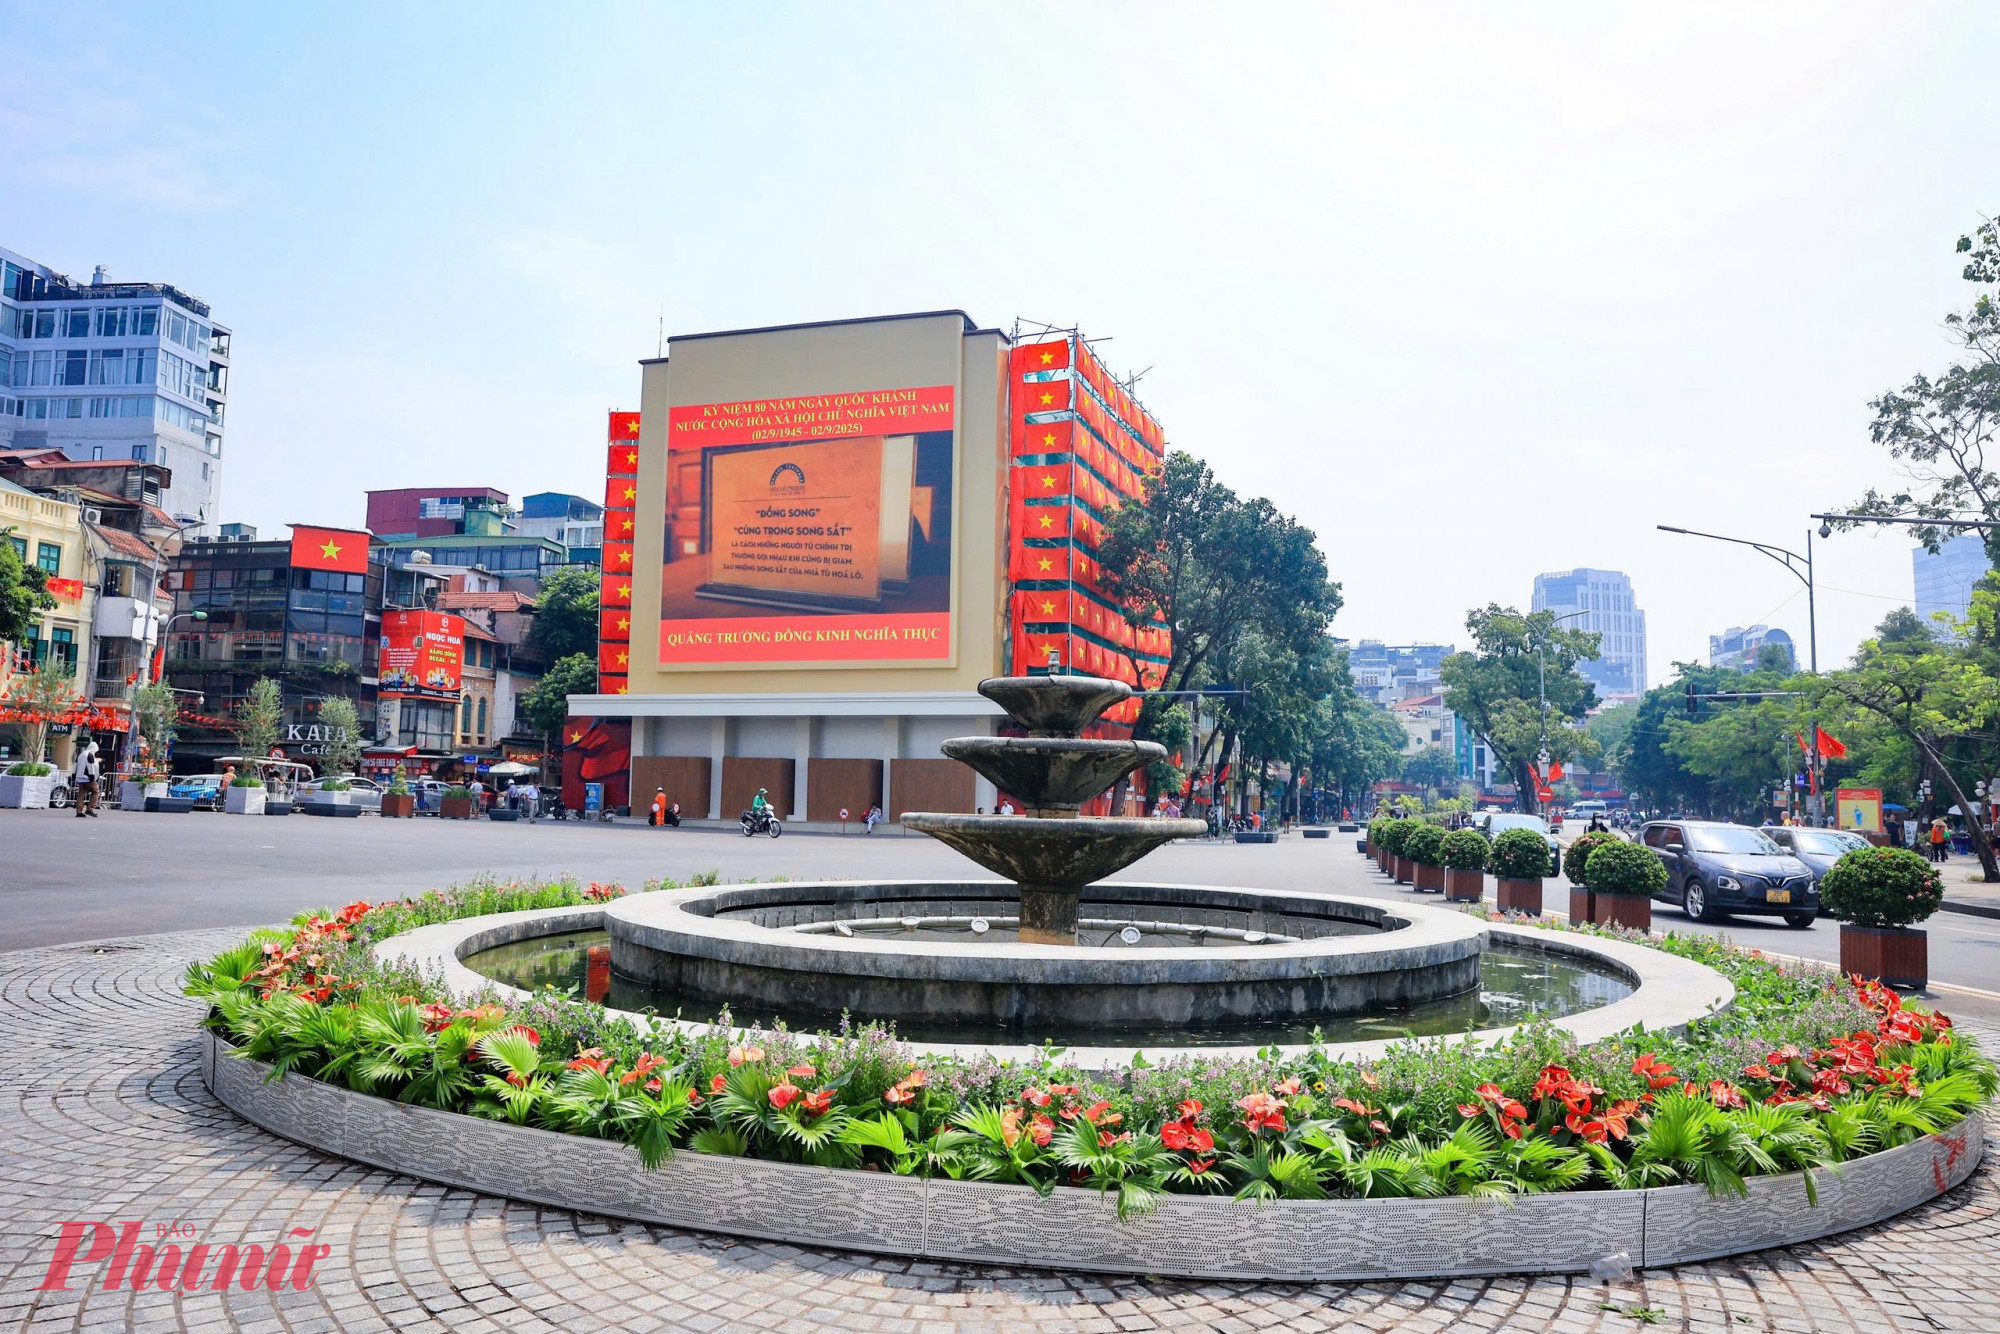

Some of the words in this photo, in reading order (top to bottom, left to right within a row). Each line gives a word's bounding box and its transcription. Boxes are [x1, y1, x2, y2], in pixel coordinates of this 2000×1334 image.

[722, 403, 752, 415] NIỆM
[754, 403, 766, 412] 80
[769, 399, 797, 412] NĂM
[798, 397, 830, 410] NGÀY
[834, 392, 869, 408] QUỐC
[872, 390, 917, 404] KHÁNH
[676, 419, 709, 432] NƯỚC
[711, 418, 744, 431] CỘNG
[746, 415, 771, 427] HÒA
[774, 412, 791, 424] XÃ
[793, 411, 816, 424] HỘI
[818, 408, 844, 421] CHỦ
[846, 405, 886, 419] NGHĨA
[888, 404, 918, 417] VIỆT
[920, 402, 950, 413] NAM
[751, 427, 803, 441] (02/9/1945
[811, 424, 863, 437] 02/9/2025)
[763, 527, 794, 536] TRONG
[796, 527, 824, 536] SONG
[832, 557, 852, 565] GIAM
[425, 632, 446, 643] NGỌC
[447, 635, 461, 645] HOA
[667, 629, 713, 646] QUẢNG
[716, 629, 771, 644] TRƯỜNG
[774, 629, 812, 643] ĐÔNG
[815, 629, 850, 642] KINH
[854, 627, 898, 641] NGHĨA
[902, 627, 941, 643] THỤC
[286, 724, 348, 742] KAFA
